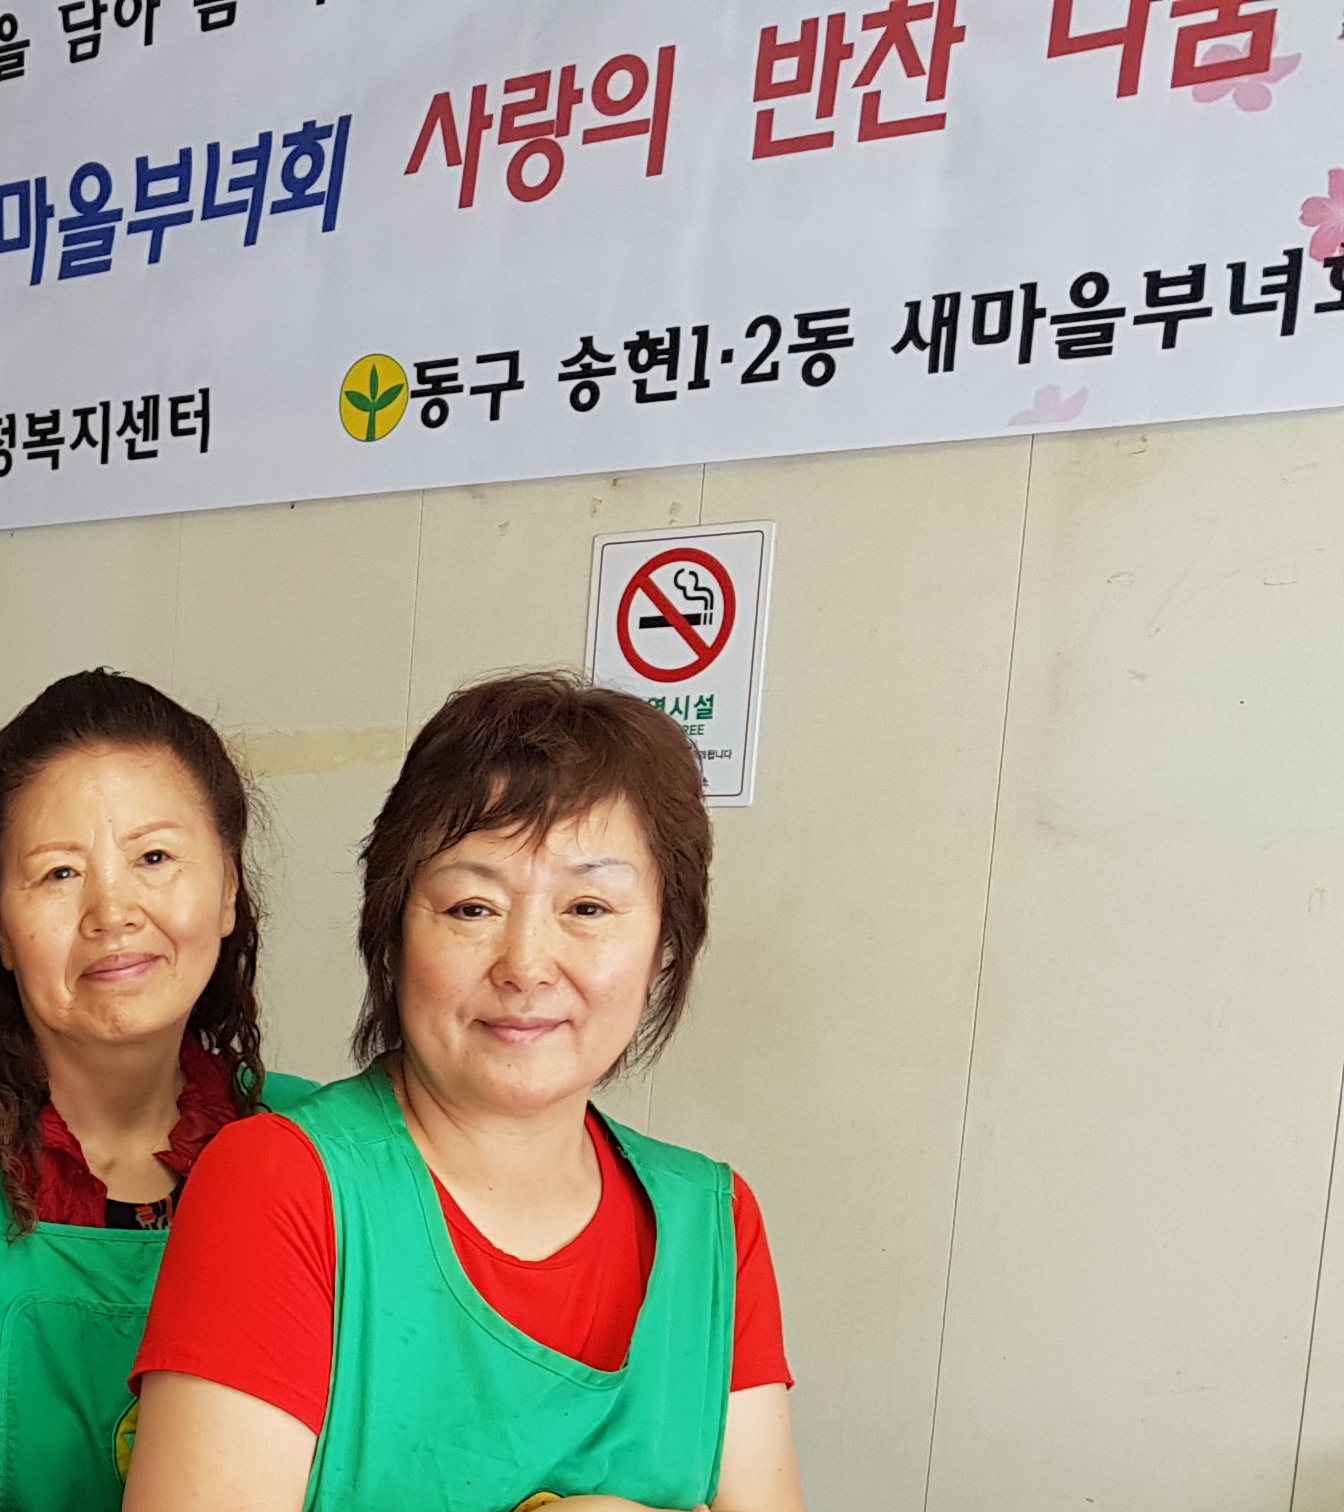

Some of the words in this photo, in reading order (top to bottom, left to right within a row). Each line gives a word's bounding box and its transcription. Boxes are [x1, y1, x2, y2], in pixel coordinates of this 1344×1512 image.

[404, 45, 677, 209] 사랑의
[752, 0, 966, 160] 반찬
[410, 350, 525, 429] 동구
[558, 308, 855, 412] 송현1·2동
